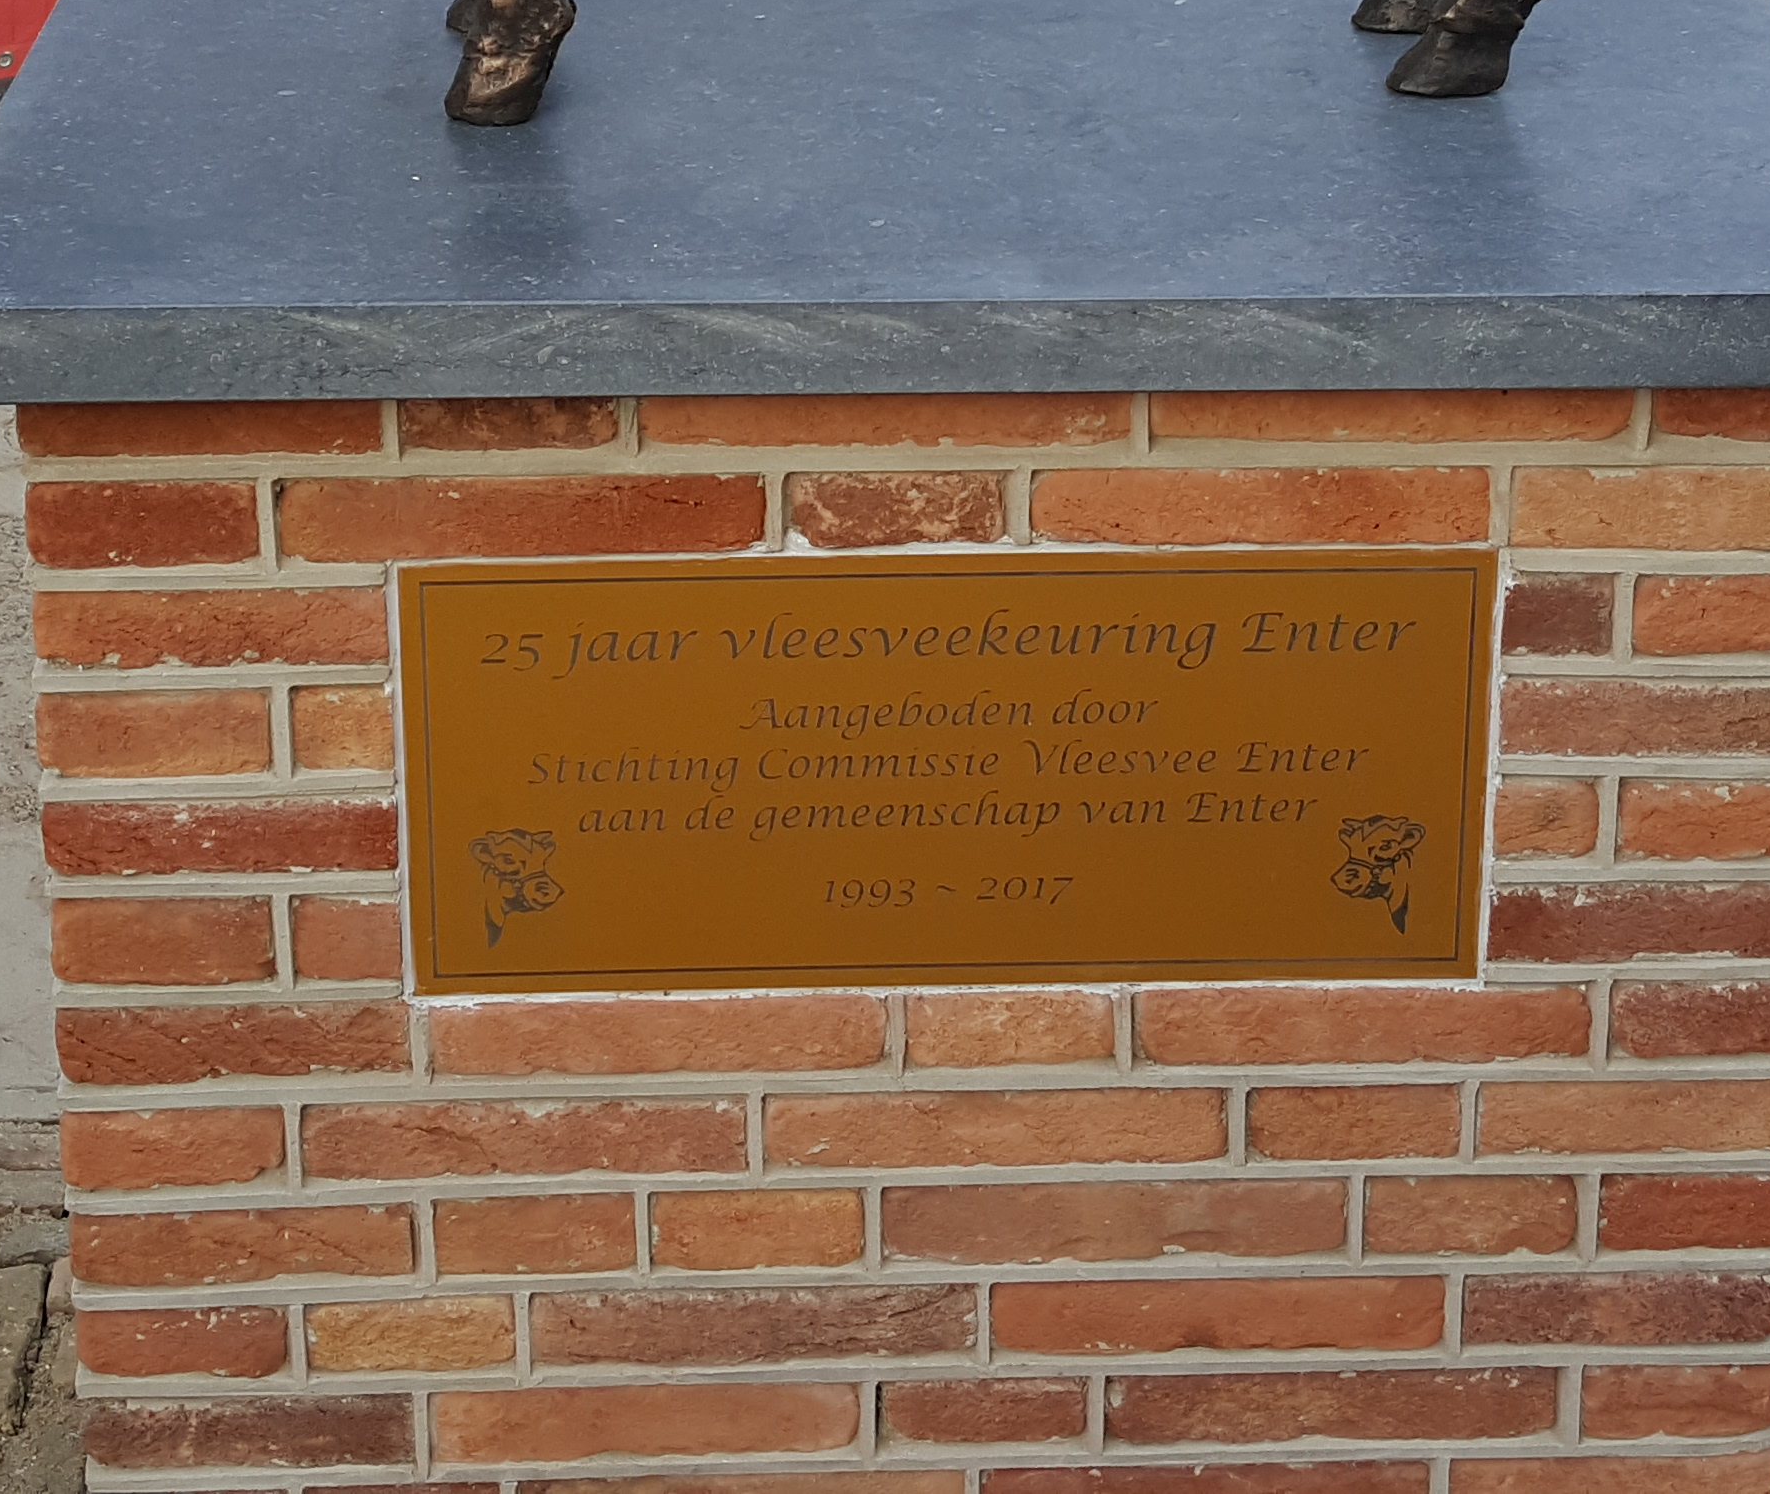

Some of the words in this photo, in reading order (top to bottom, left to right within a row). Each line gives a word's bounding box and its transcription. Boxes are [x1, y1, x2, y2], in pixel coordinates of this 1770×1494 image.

[479, 632, 545, 672] 25
[551, 621, 698, 680] jaar
[719, 608, 1218, 670] vleesveekeuring
[1240, 611, 1418, 653] Enter
[738, 690, 1033, 741] Aangeboden
[1051, 688, 1160, 726] door
[527, 746, 740, 794] Stichting
[757, 746, 1000, 782] Commissie
[1022, 738, 1218, 776] Vleesvee
[1236, 740, 1370, 774] Enter
[578, 808, 667, 834] aan
[684, 795, 736, 832] de
[748, 790, 1061, 843] gemeenschap
[1078, 799, 1167, 826] van
[1185, 791, 1319, 824] Enter
[823, 877, 917, 910] 1993
[975, 875, 1075, 906] 2017
